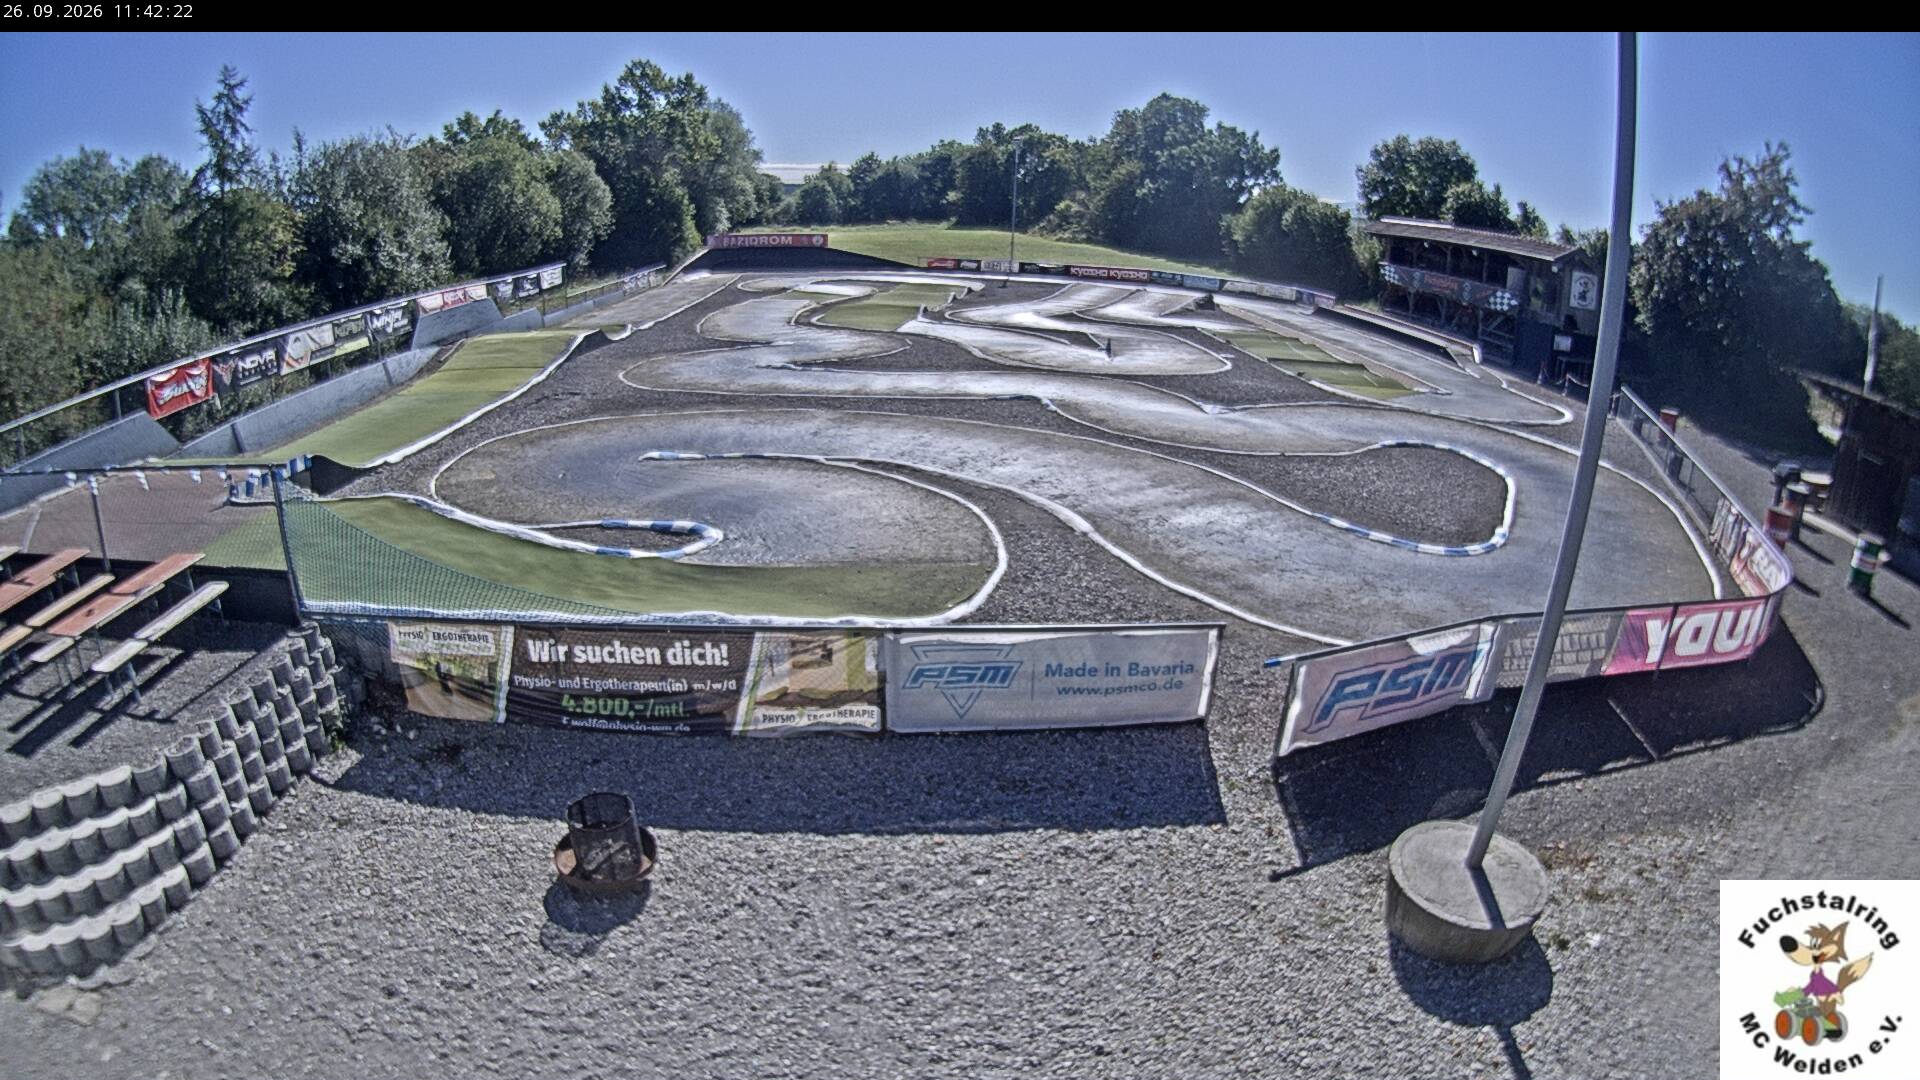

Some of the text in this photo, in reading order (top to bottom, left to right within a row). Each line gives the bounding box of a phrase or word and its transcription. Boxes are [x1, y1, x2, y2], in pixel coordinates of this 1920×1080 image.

[527, 638, 730, 667] Wir suchen dich!
[906, 663, 1018, 688] PSM
[1044, 660, 1195, 678] Made in Bavaria
[513, 674, 737, 693] Physio- und Ergotherapeut(in) m/w/d
[1055, 678, 1184, 696] www.psmco.de
[1310, 646, 1487, 727] PSM
[761, 712, 797, 724] PHYSIO
